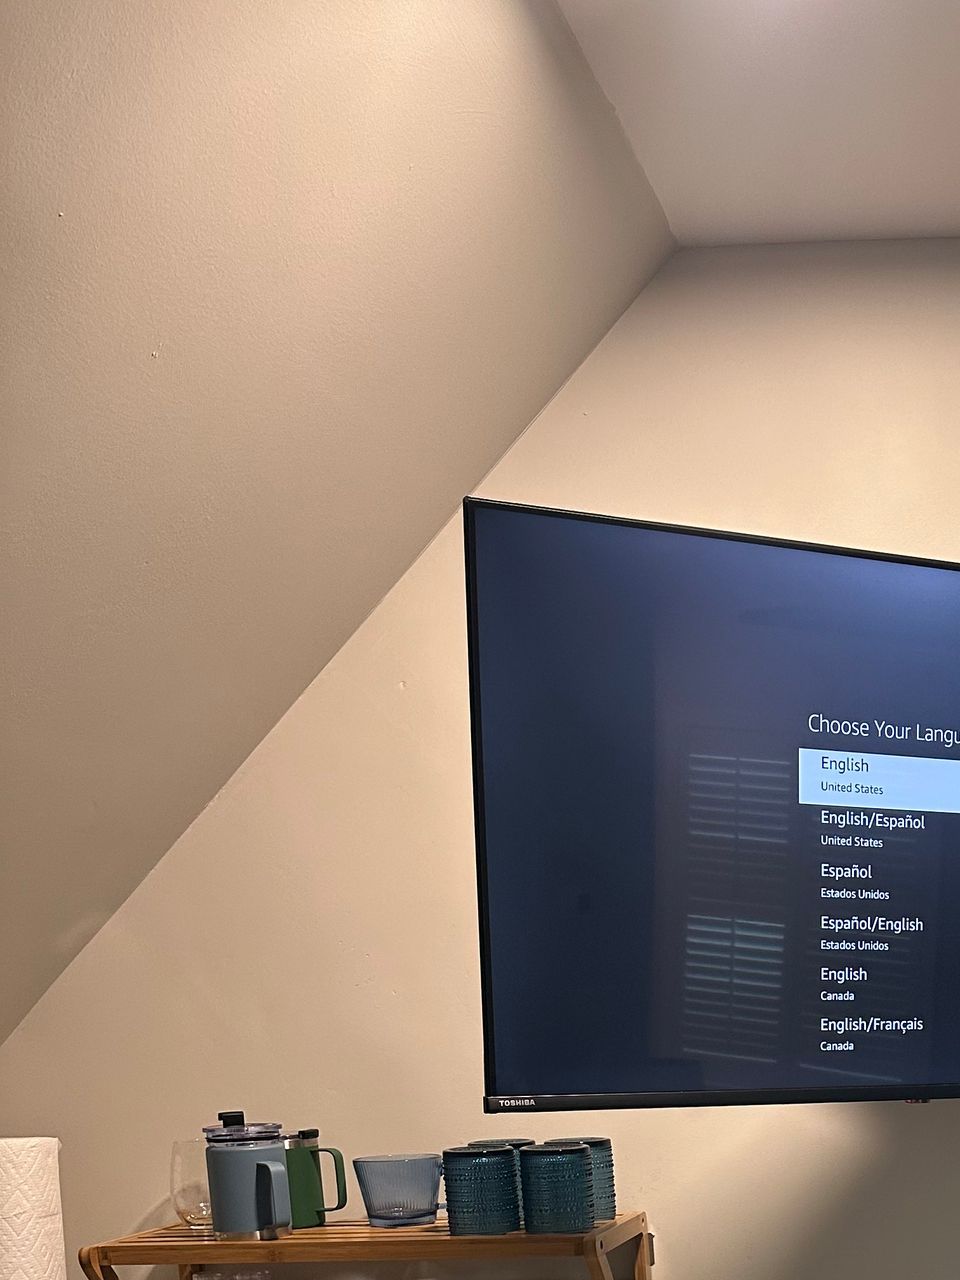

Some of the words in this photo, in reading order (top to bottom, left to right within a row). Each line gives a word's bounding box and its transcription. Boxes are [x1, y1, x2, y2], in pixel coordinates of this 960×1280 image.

[808, 714, 870, 737] Choose
[874, 720, 911, 740] Your
[821, 756, 869, 774] English
[821, 782, 852, 794] United
[854, 783, 884, 795] States
[821, 810, 925, 831] English/Español
[821, 835, 852, 847] United
[854, 836, 883, 848] States
[821, 863, 873, 881] Español
[820, 888, 856, 899] Estados
[858, 889, 890, 900] Unidos
[821, 916, 924, 934] Español/English
[820, 939, 856, 951] Estados
[858, 940, 889, 951] Unidos
[820, 967, 868, 984] English
[820, 990, 855, 1001] Canada
[820, 1017, 924, 1035] English/Français
[820, 1040, 854, 1052] Canada
[498, 1099, 536, 1107] TOSHIBA
